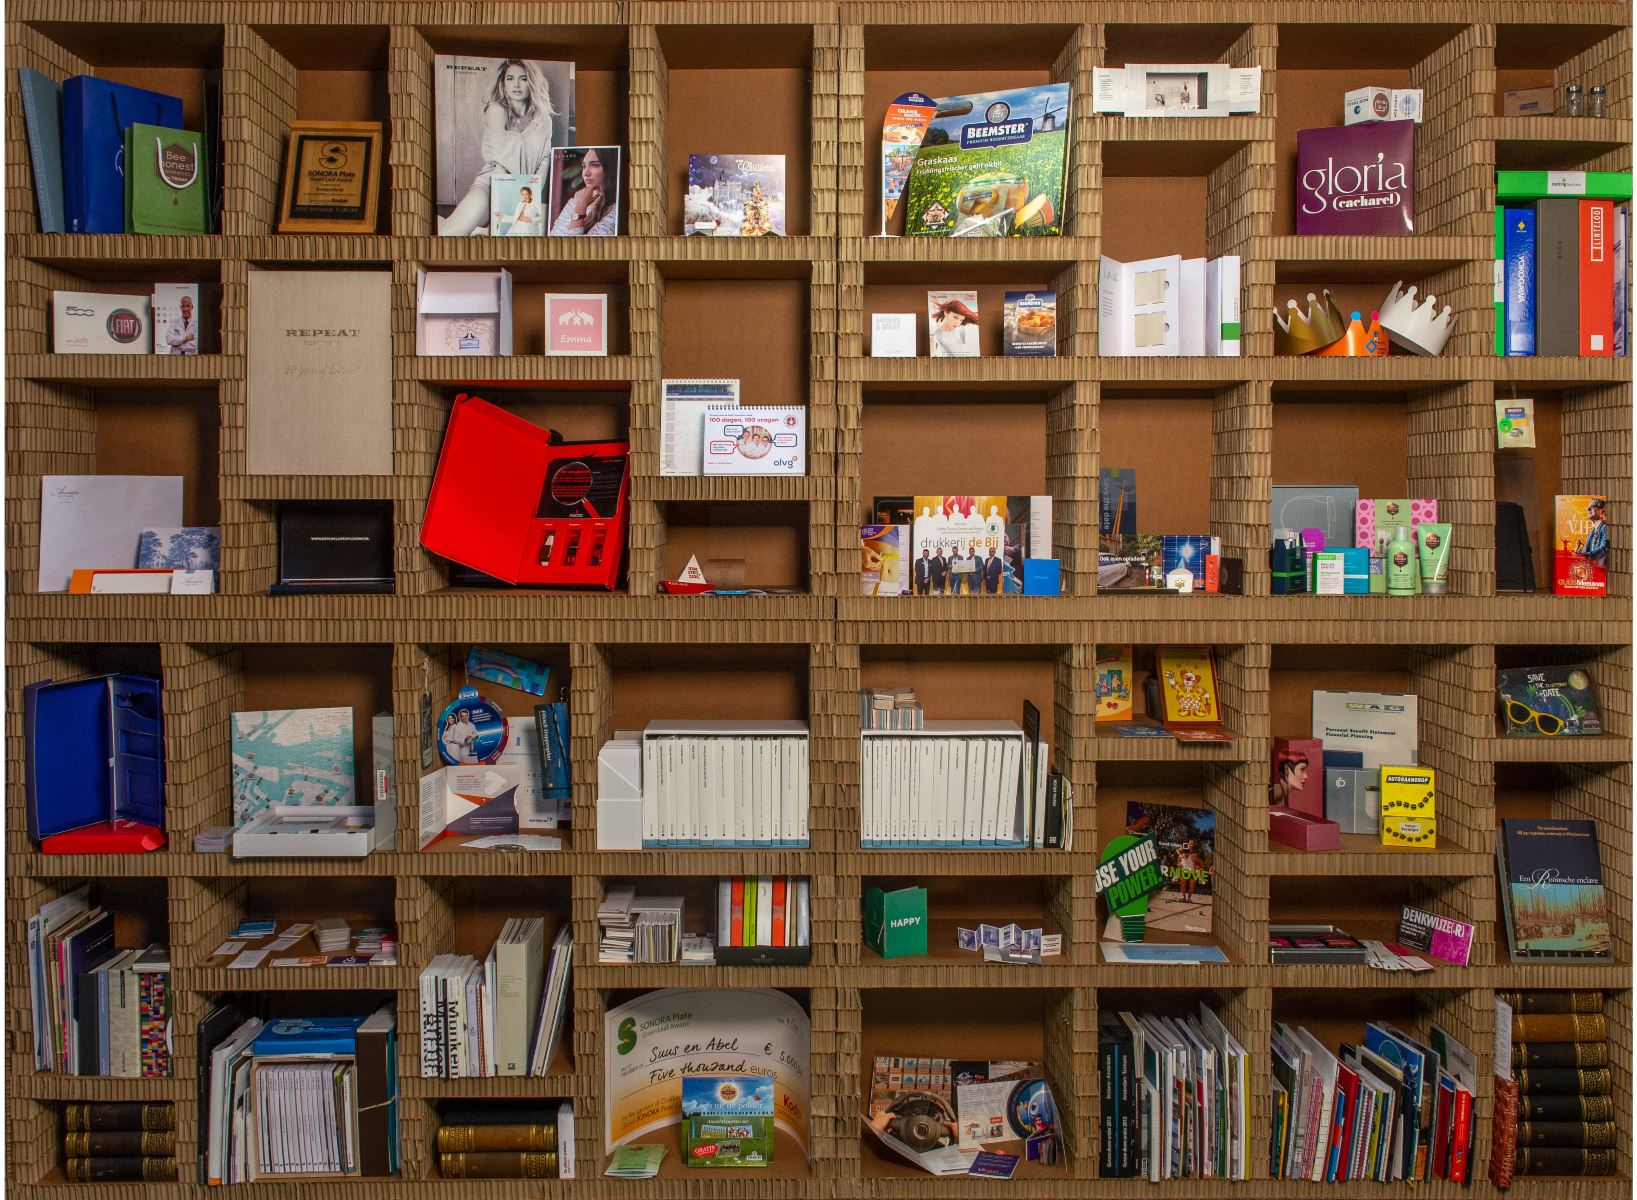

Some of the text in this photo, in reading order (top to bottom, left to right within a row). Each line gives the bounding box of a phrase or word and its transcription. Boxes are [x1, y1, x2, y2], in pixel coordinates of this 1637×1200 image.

[446, 64, 488, 72] REPEAT
[967, 123, 1025, 139] BEEMSTER
[166, 150, 187, 162] Bee
[917, 155, 958, 166] Graskaas
[308, 170, 338, 178] SONORA
[916, 165, 968, 175] Frühlingsfrischer
[969, 162, 984, 171] geht
[1302, 152, 1408, 214] gloria
[1592, 210, 1601, 248] LINTELOO
[1518, 255, 1527, 303] YOKOGAWA
[115, 319, 135, 334] FIAT
[285, 329, 361, 337] REPEAT
[560, 334, 592, 344] Emma
[773, 458, 794, 469] olvg
[1103, 512, 1111, 530] date
[920, 537, 999, 550] drukkerij de Bij
[1527, 673, 1545, 683] SAVE
[1542, 688, 1560, 697] DATE
[1118, 839, 1158, 876] YOUR
[1168, 866, 1209, 882] MOVE
[1107, 864, 1163, 909] POWER.
[890, 916, 921, 928] HAPPY
[640, 1011, 693, 1032] SONORA Plate
[649, 1036, 739, 1063] Suus en Abel
[763, 1042, 773, 1056] €
[649, 1067, 676, 1084] Five
[750, 1066, 778, 1080] euros
[694, 1145, 716, 1154] GRATIS
